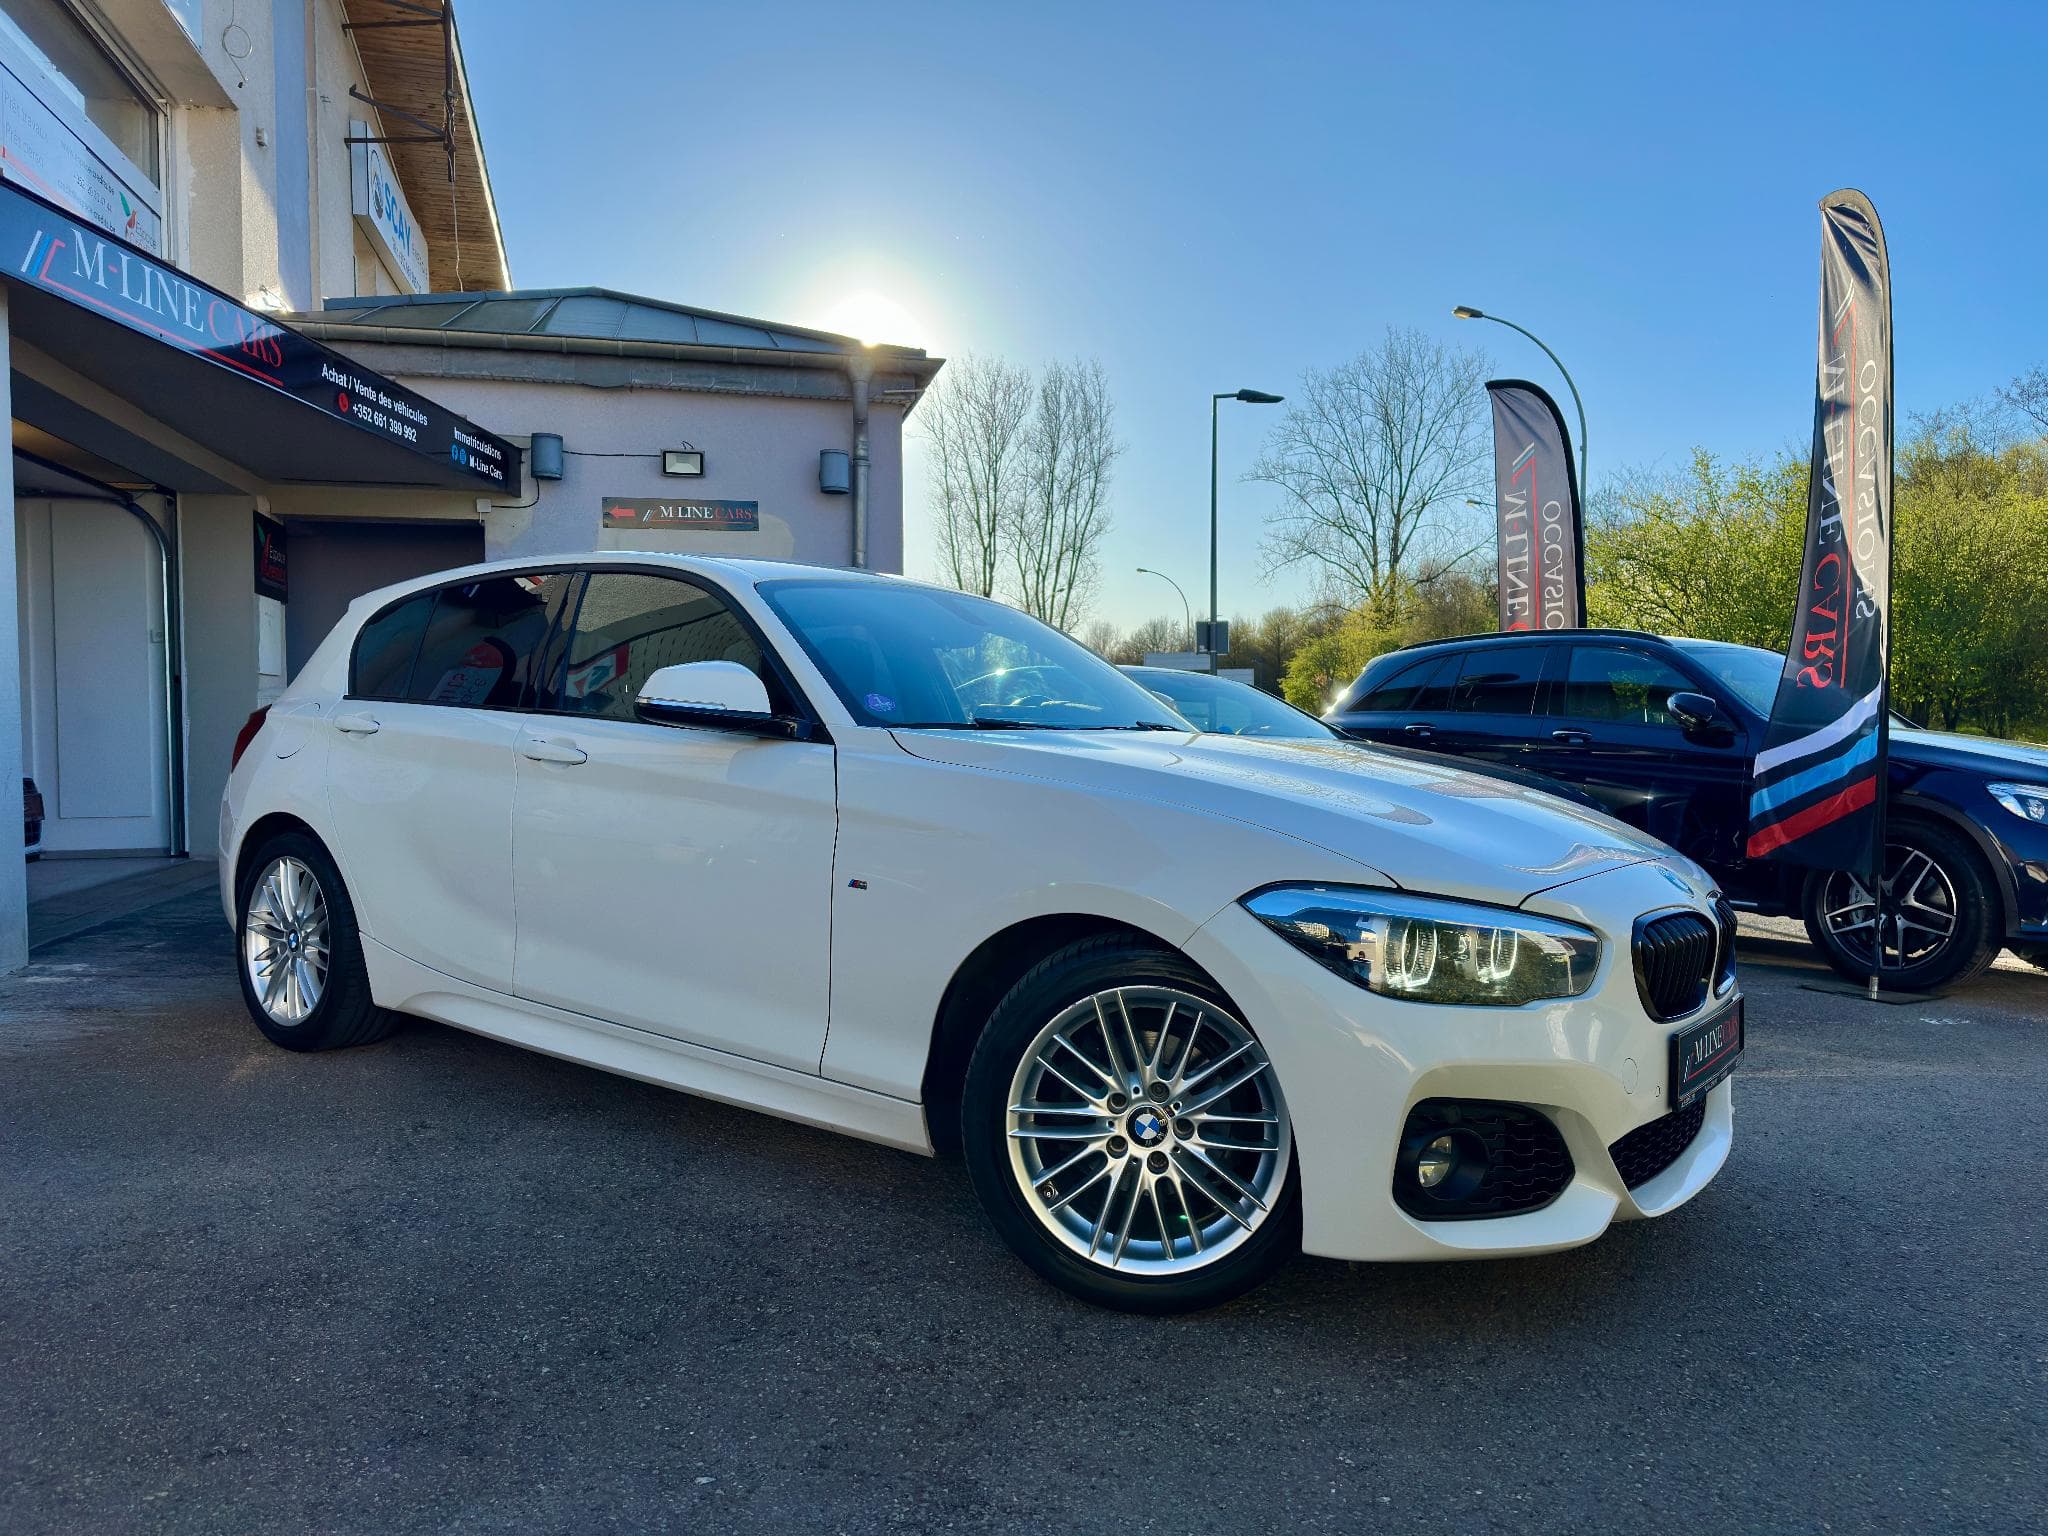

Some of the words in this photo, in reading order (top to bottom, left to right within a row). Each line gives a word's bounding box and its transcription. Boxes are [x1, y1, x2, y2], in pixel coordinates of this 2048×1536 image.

[384, 182, 411, 257] SCAY
[70, 228, 205, 333] M-LINE
[207, 299, 284, 369] CARS
[321, 363, 348, 388] Achat
[354, 377, 377, 402] Vente
[378, 391, 392, 410] des
[394, 400, 428, 426] véhicules
[352, 403, 373, 424] +352
[373, 411, 388, 430] 661
[389, 420, 403, 436] 399
[403, 424, 417, 443] 992
[454, 426, 502, 461] Immatriculations
[469, 454, 489, 475] M-Line
[489, 464, 503, 480] Cars
[659, 505, 714, 519] M-LINE
[715, 507, 752, 519] CARS
